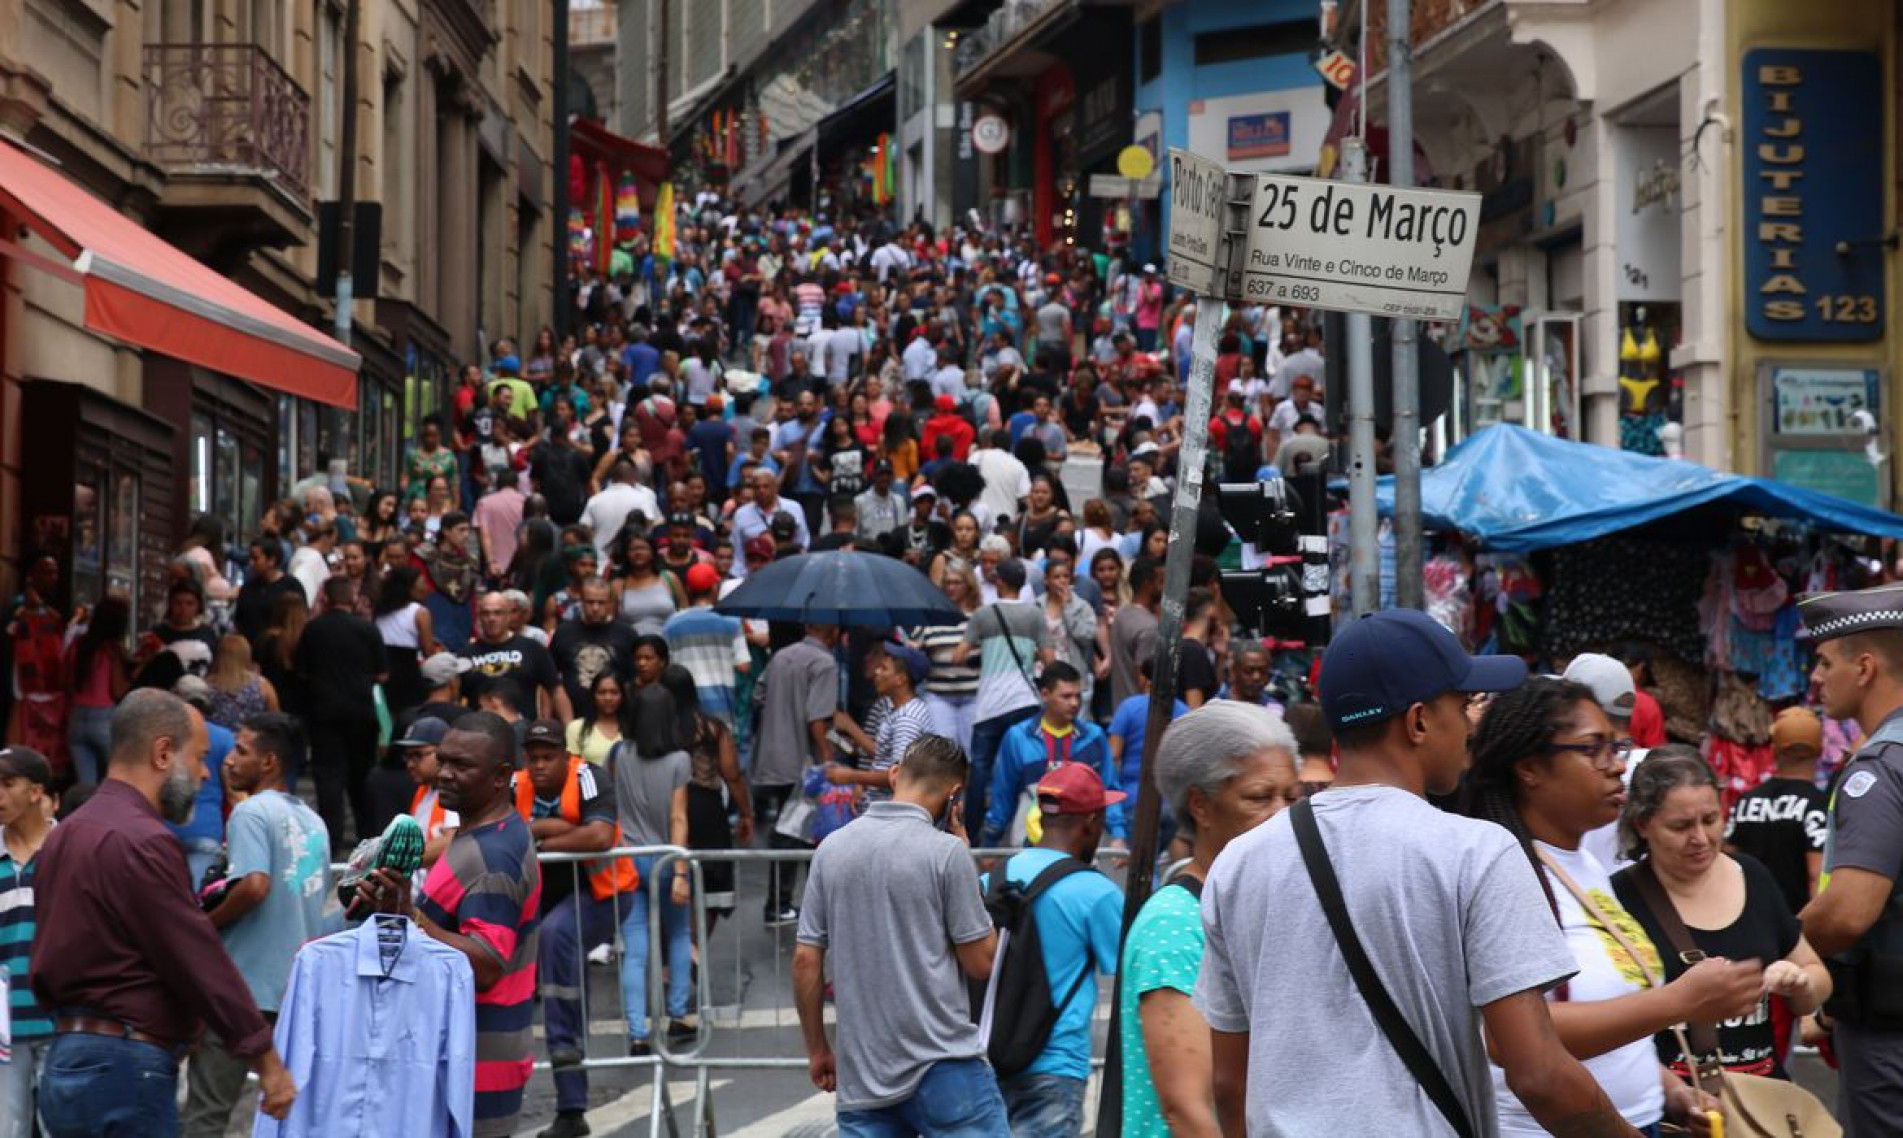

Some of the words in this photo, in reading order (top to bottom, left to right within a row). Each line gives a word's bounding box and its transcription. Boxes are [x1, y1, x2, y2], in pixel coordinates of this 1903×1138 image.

[1325, 55, 1354, 86] 10
[1173, 157, 1203, 214] Porto
[1758, 66, 1806, 320] BIJUTERIAS
[1258, 183, 1298, 230] 25
[1310, 185, 1354, 235] de
[1366, 192, 1467, 258] Março
[1251, 250, 1280, 267] Rua
[1285, 253, 1321, 273] Vinte
[1325, 261, 1335, 273] e
[1339, 259, 1382, 278] Cinco
[1385, 264, 1404, 281] de
[1407, 266, 1449, 287] Março
[1248, 279, 1274, 296] 637
[1277, 285, 1287, 297] a
[1291, 284, 1320, 301] 693
[1816, 297, 1877, 322] 123
[472, 650, 522, 666] WORLD
[1341, 706, 1382, 723] OAKLEY
